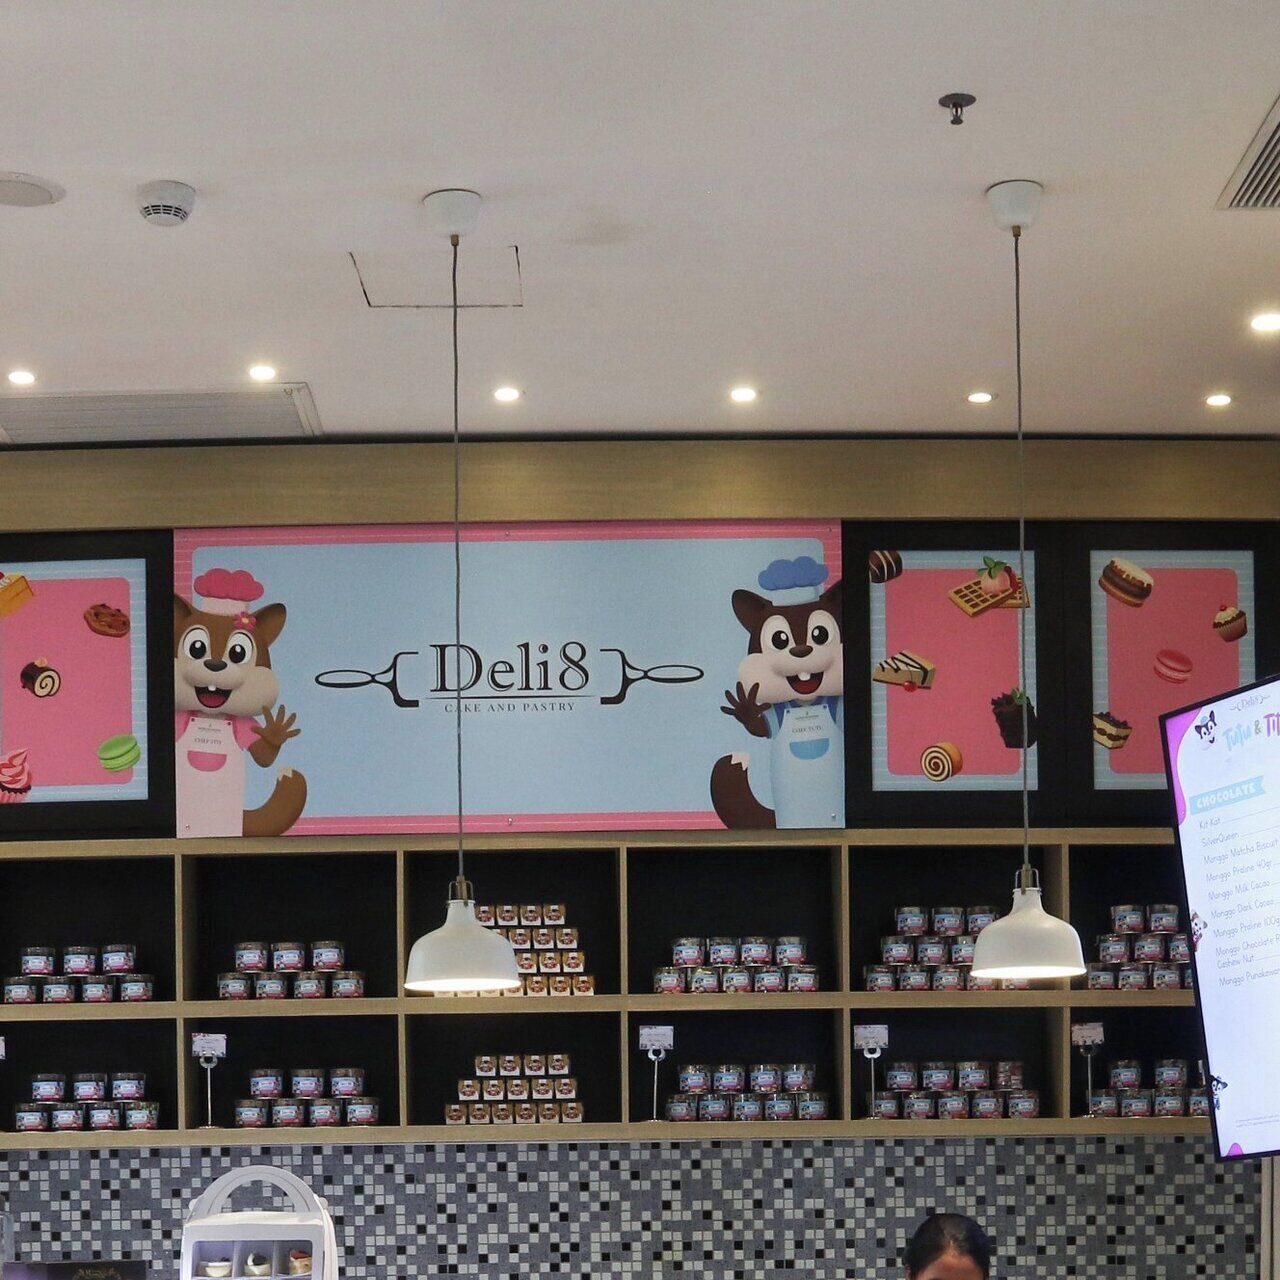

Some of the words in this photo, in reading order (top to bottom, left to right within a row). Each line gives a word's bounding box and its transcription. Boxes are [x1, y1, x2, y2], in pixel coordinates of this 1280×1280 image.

[429, 641, 589, 693] Deli8
[487, 703, 516, 712] AND
[523, 702, 575, 711] PASTRY
[1254, 719, 1262, 735] &
[1196, 782, 1256, 809] CHOCOLATE
[1201, 832, 1239, 848] SilverQueen
[1204, 854, 1229, 866] Monggo
[1230, 845, 1255, 858] Matcha
[1256, 838, 1279, 851] Biscuit
[1206, 871, 1231, 883] Monggo
[1232, 864, 1255, 876] Praline
[1208, 890, 1234, 902] Monggo
[1235, 884, 1249, 895] Milk
[1250, 879, 1271, 890] Cacao
[1211, 908, 1236, 920] Monggo
[1237, 902, 1252, 914] Dark
[1254, 898, 1275, 909] Cacao
[1213, 927, 1239, 939] Monggo
[1239, 921, 1262, 933] Praline
[1216, 945, 1241, 957] Monggo
[1241, 938, 1273, 950] Chocolate
[1216, 958, 1241, 970] Cashew
[1242, 954, 1255, 963] Nut
[1219, 976, 1245, 987] Monggo
